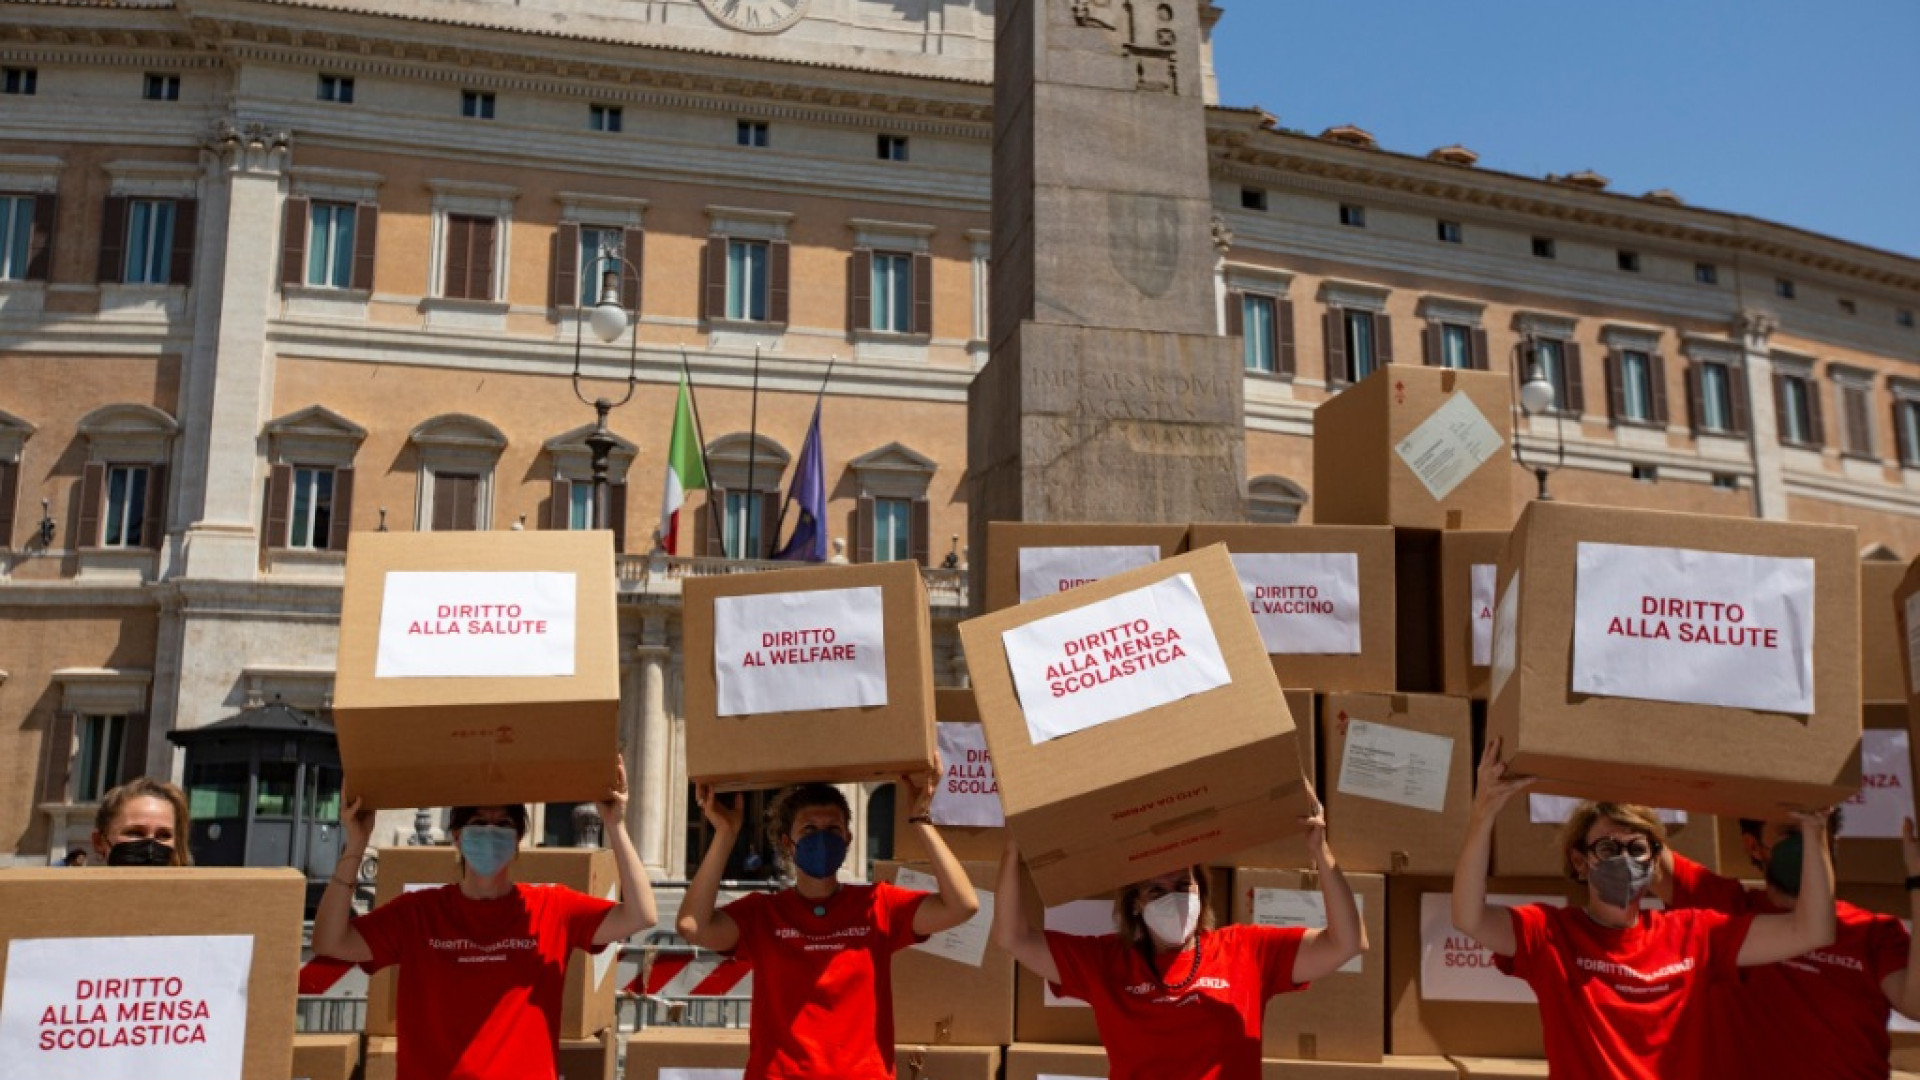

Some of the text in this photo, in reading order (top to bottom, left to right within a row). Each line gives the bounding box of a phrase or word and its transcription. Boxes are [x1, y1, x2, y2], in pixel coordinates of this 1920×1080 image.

[1255, 586, 1319, 599] DIRITTO
[437, 604, 523, 618] DIRITTO
[1263, 601, 1334, 614] VACCINO
[1640, 596, 1745, 623] DIRITTO
[408, 619, 548, 635] ALLA SALUTE
[762, 627, 837, 648] DIRITTO
[1063, 618, 1150, 657] DIRITTO
[1607, 616, 1777, 649] ALLA SALUTE
[743, 644, 856, 667] AL WELFARE
[1045, 627, 1182, 681] ALLA MENSA
[1050, 644, 1187, 698] SCOLASTICA
[948, 765, 986, 778] ALLA
[948, 780, 999, 794] SCOLA
[1444, 936, 1483, 952] ALLA
[76, 975, 185, 1000] DIRITTO
[39, 998, 211, 1026] ALLA MENSA
[39, 1023, 208, 1051] SCOLASTICA
